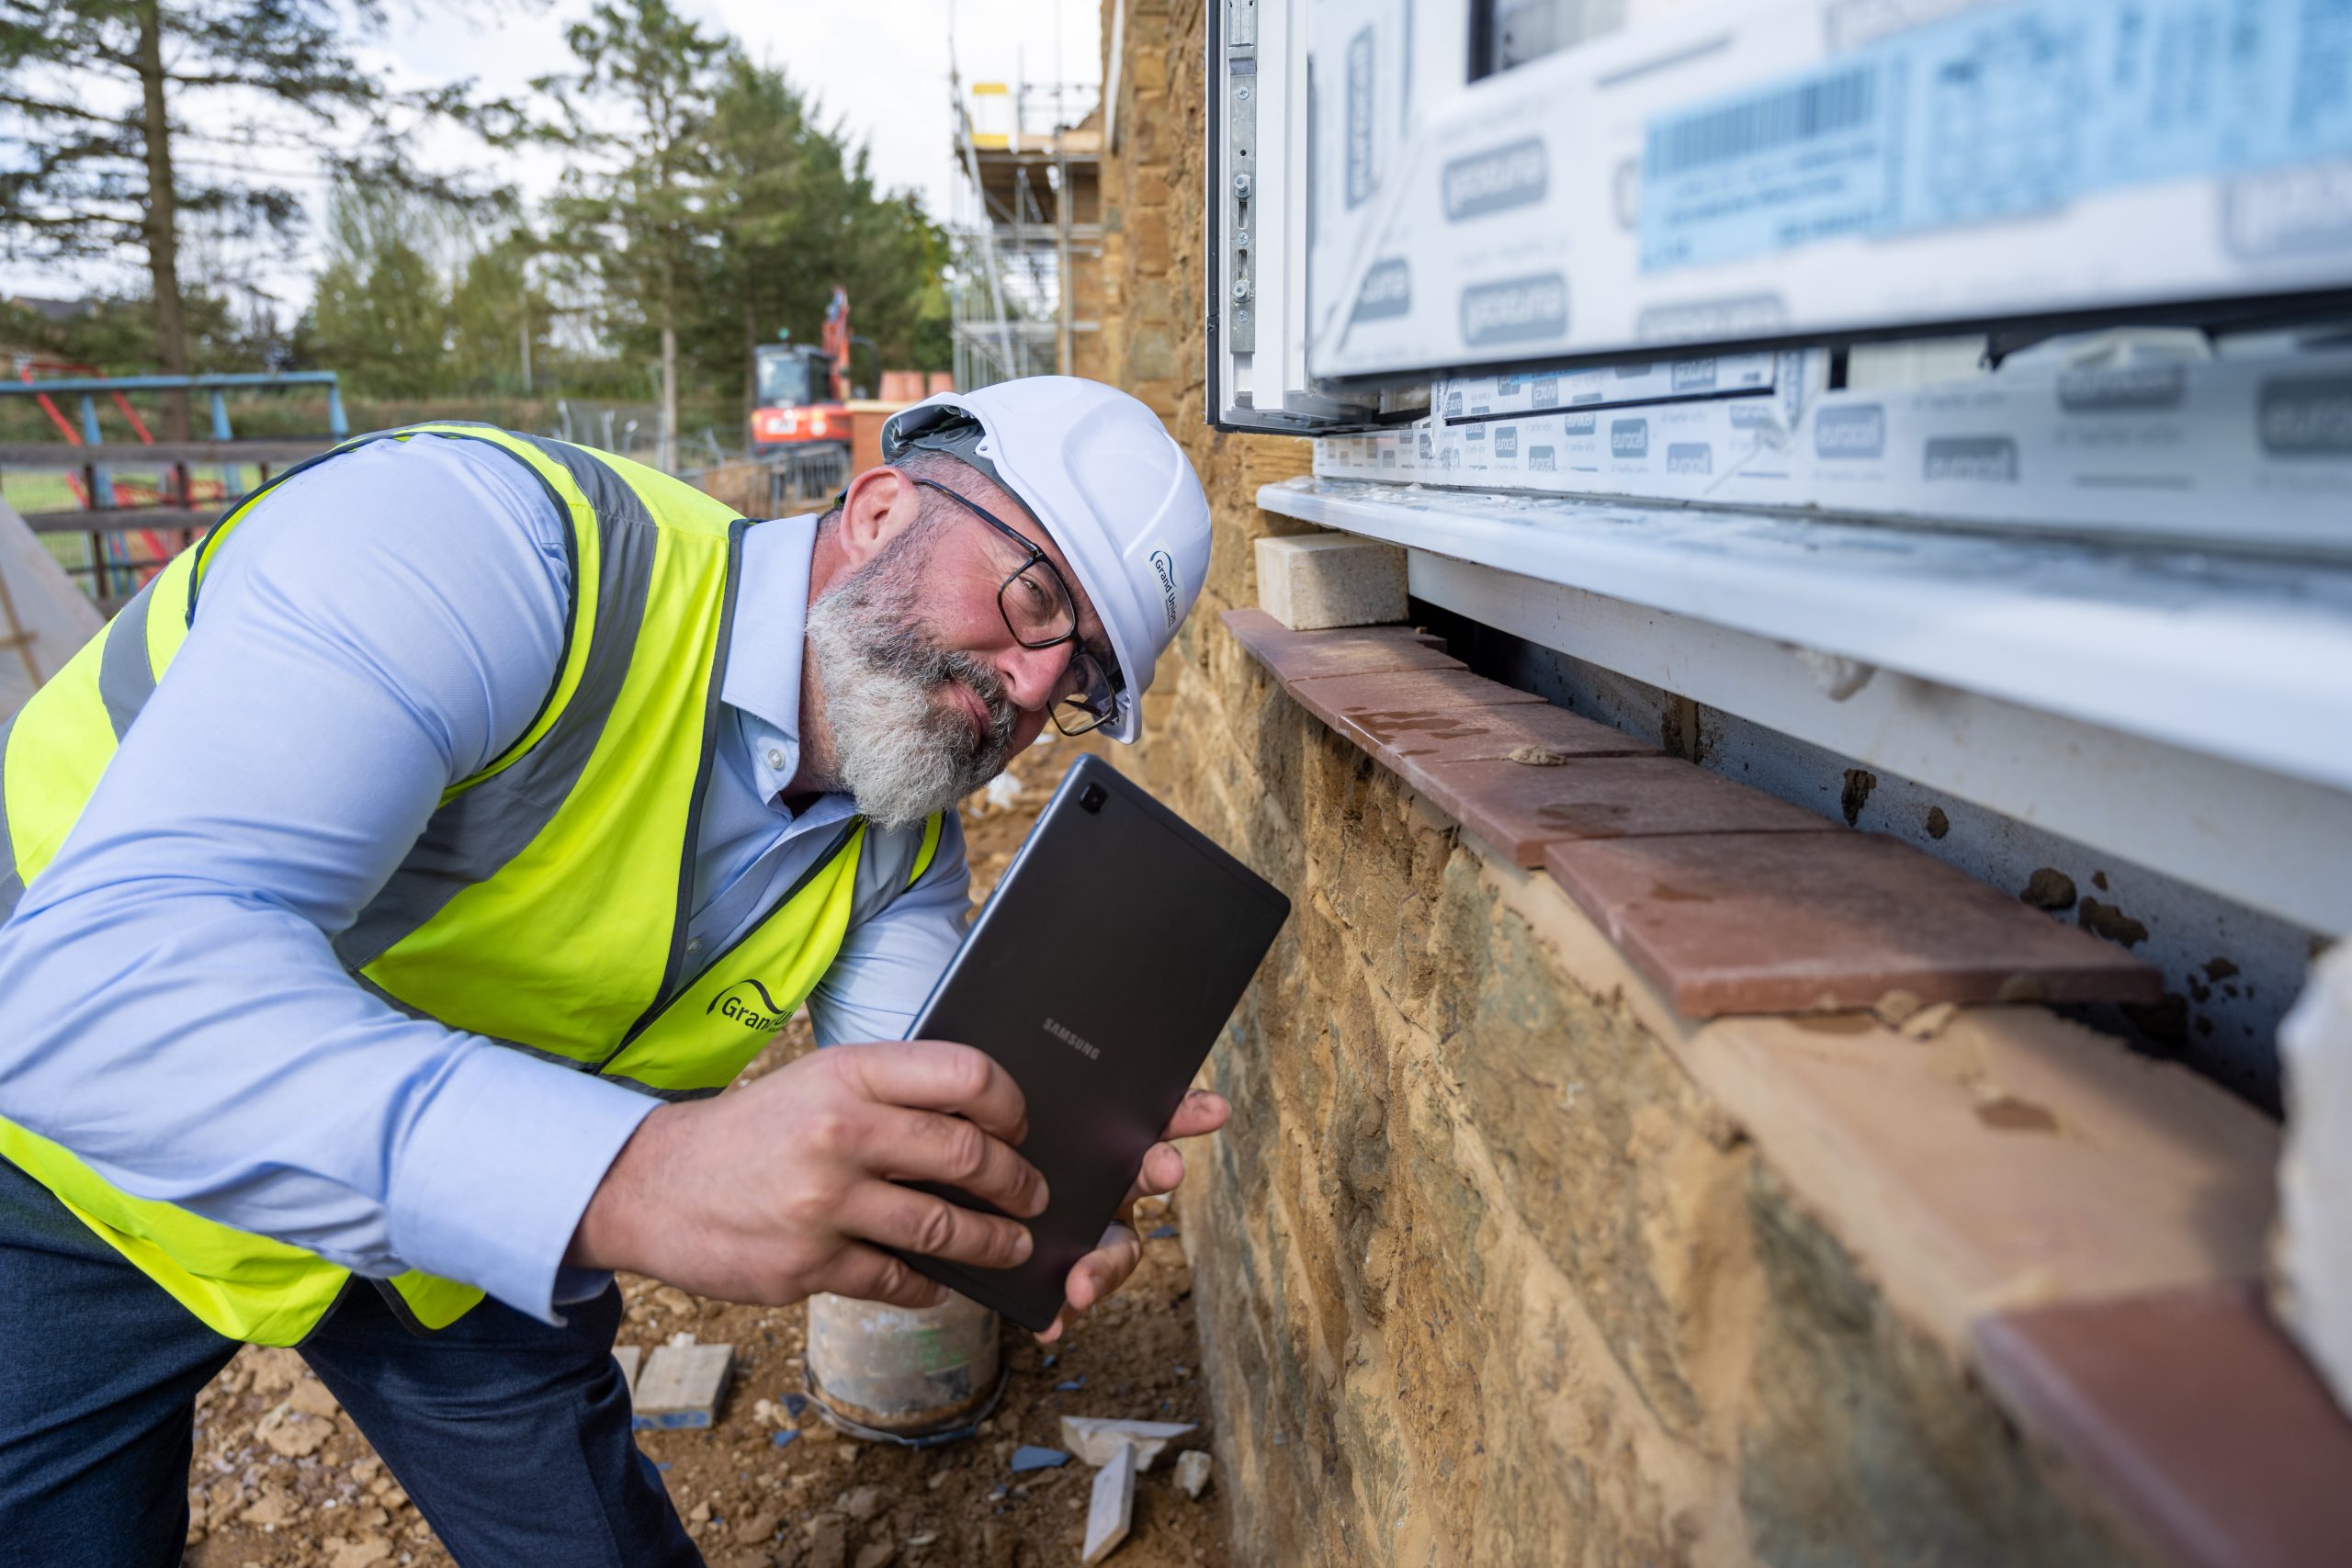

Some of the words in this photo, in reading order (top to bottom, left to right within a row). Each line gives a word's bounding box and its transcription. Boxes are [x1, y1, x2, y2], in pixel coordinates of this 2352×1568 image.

[1155, 558, 1172, 593] Grand
[1168, 592, 1178, 625] Union
[1043, 1017, 1101, 1060] SAMSUNG
